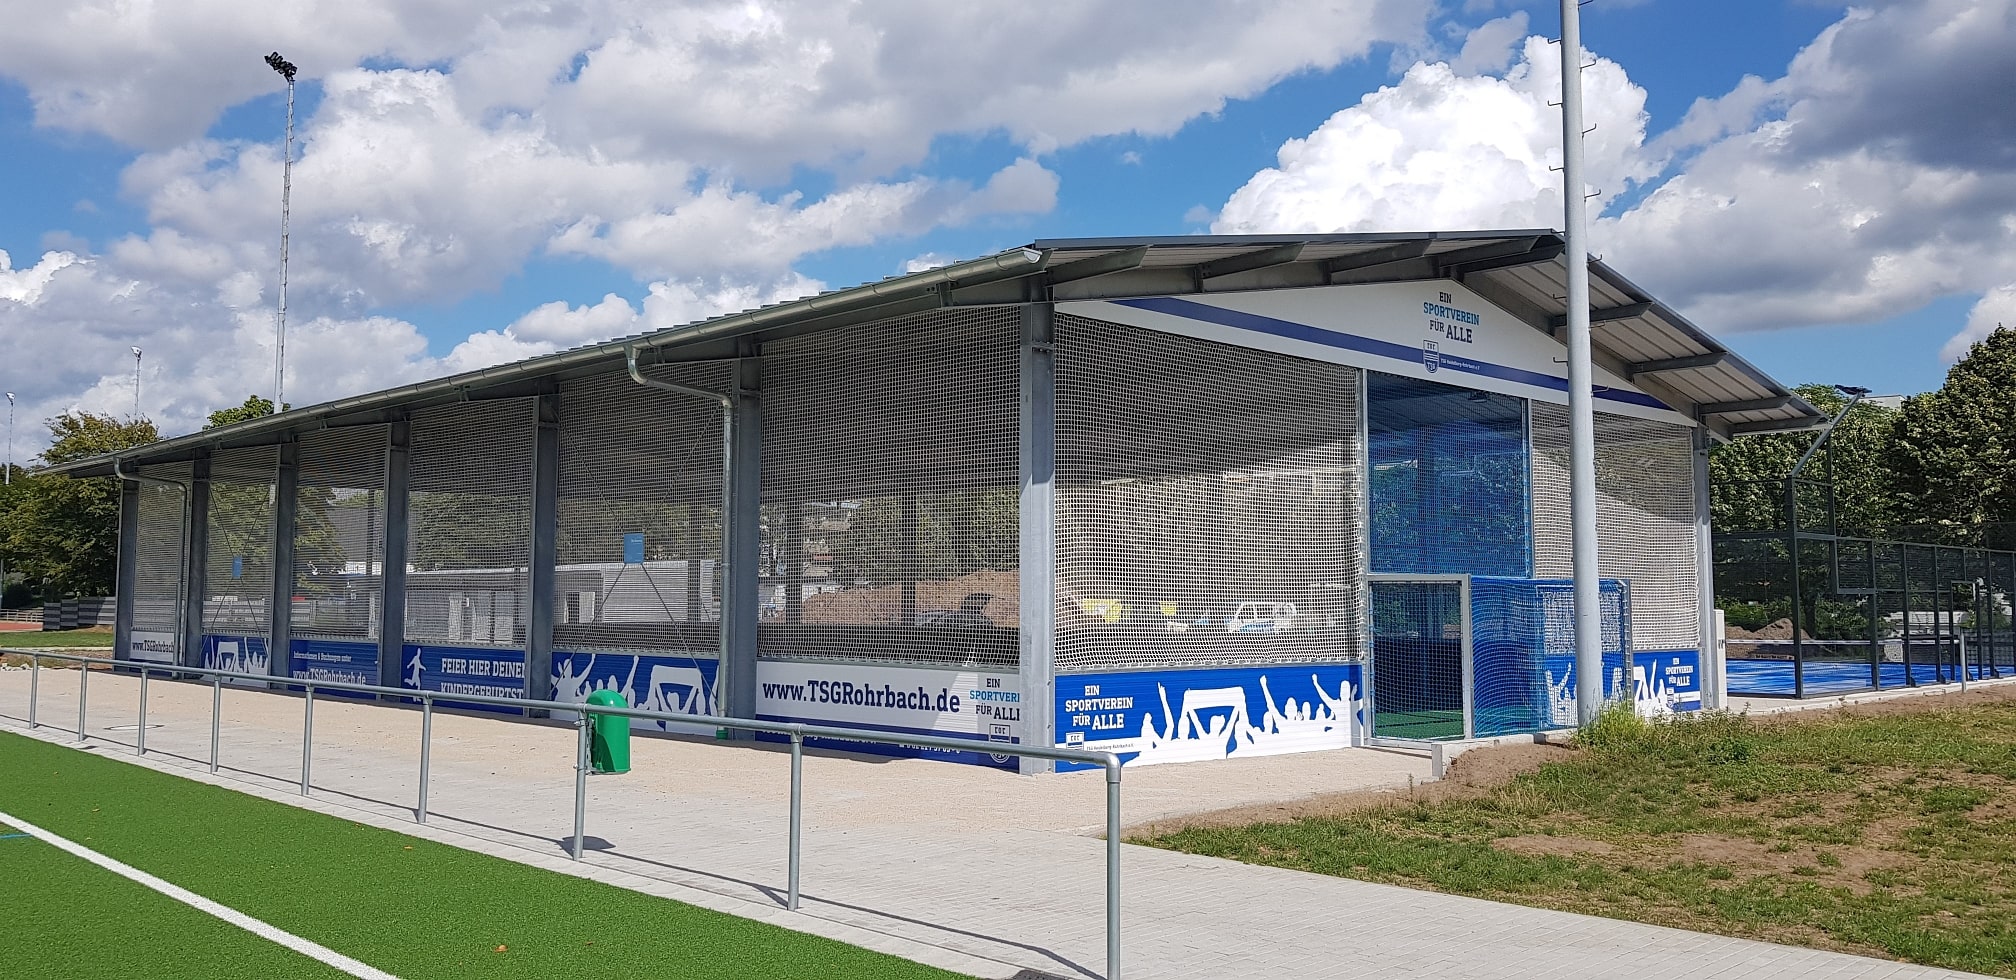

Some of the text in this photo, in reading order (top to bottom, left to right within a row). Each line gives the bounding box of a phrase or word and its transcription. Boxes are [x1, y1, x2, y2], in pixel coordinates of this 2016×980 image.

[1439, 291, 1452, 304] EIN
[1423, 301, 1480, 326] SPORTVEREIN
[1429, 318, 1472, 343] FÜR ALLE
[441, 658, 467, 675] FEIER
[468, 659, 491, 676] HIER
[986, 678, 1001, 688] EIN
[1677, 676, 1690, 686] ALLE
[762, 680, 961, 713] www.TSGRohrbach.de
[1084, 685, 1100, 696] EIN
[975, 702, 992, 715] FÜR
[1065, 697, 1133, 712] SPORTVEREIN
[1072, 712, 1124, 730] FÜR ALLE
